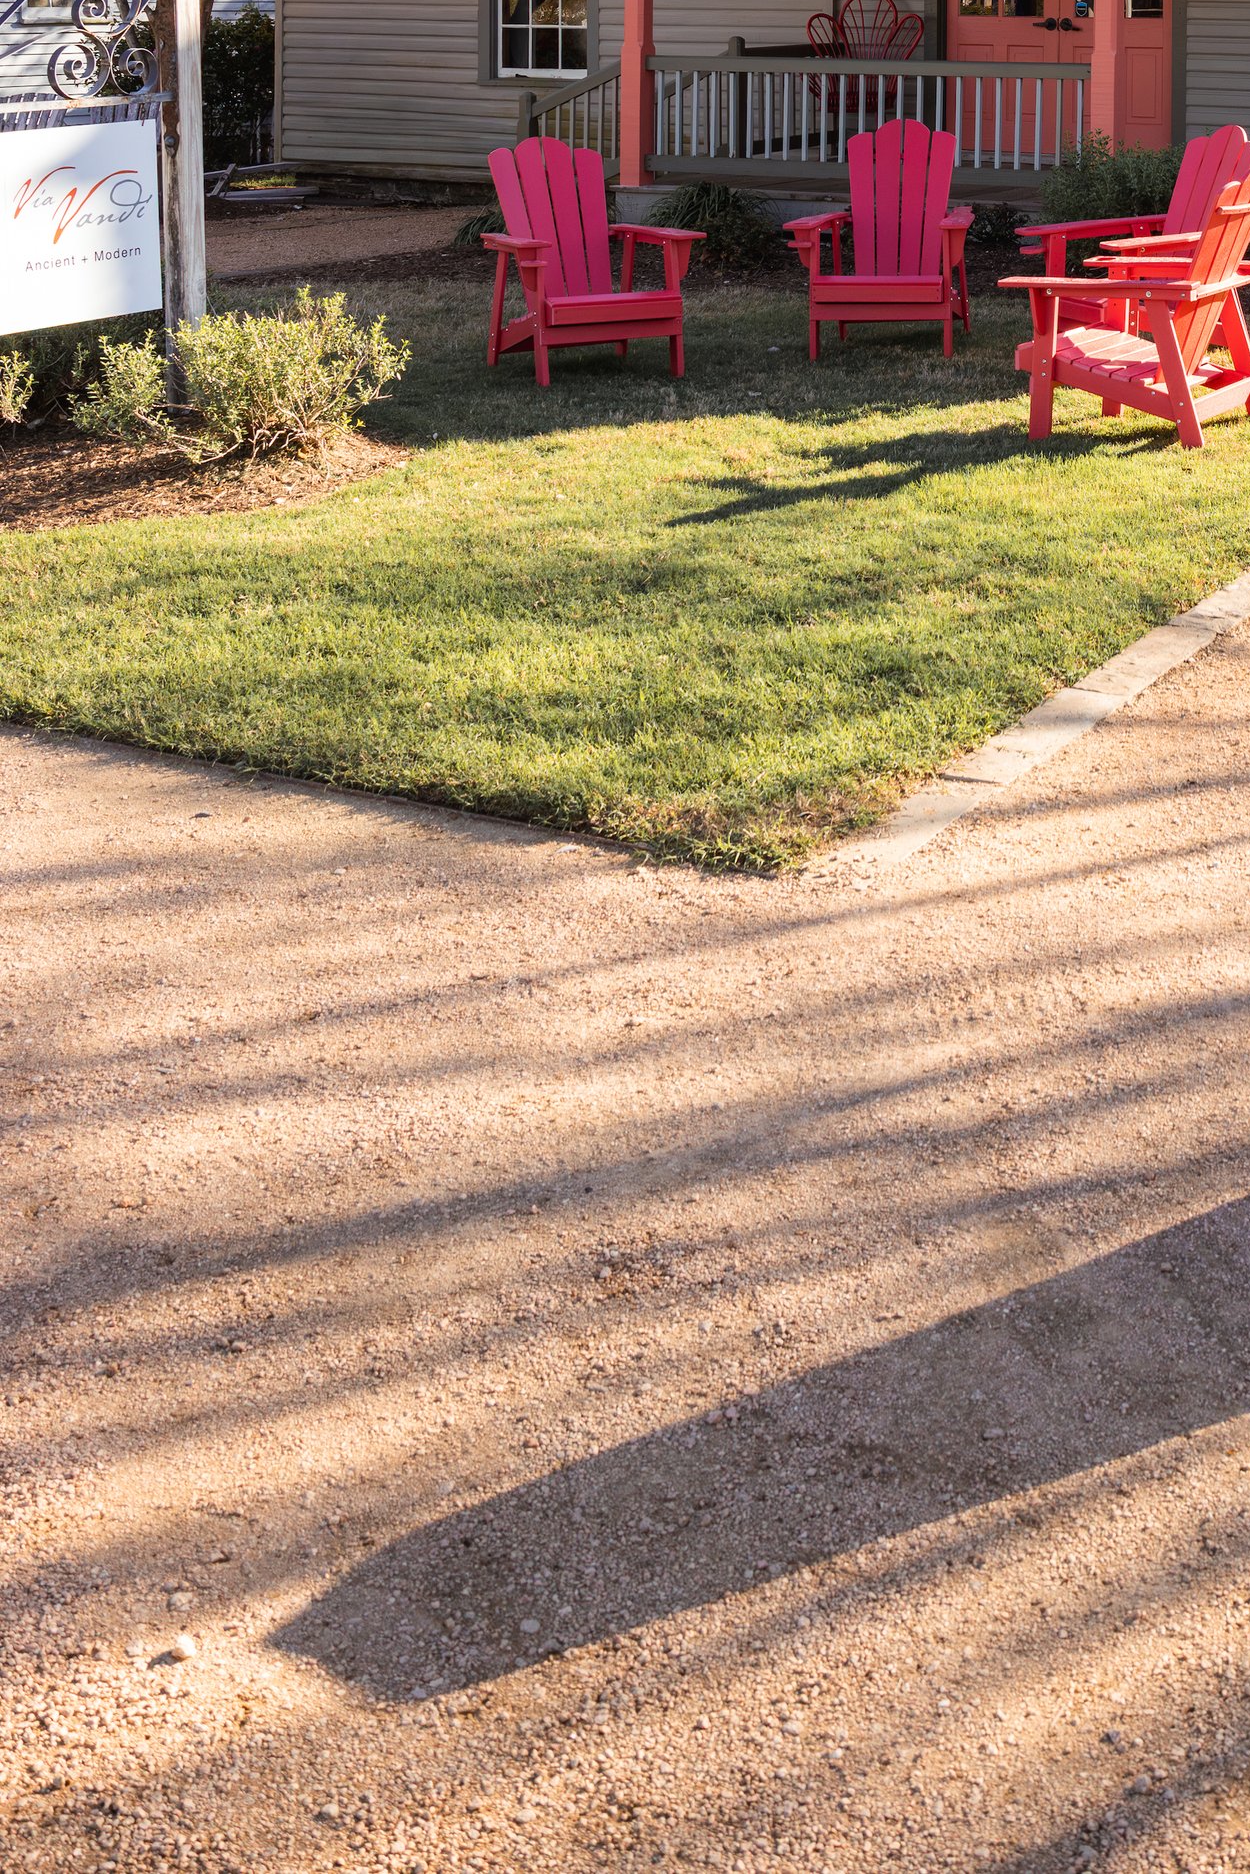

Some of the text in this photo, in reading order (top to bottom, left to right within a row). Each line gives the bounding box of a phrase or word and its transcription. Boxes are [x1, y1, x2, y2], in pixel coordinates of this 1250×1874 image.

[13, 166, 153, 244] Via Vandi
[25, 255, 76, 272] Ancient
[94, 247, 142, 262] Modern
